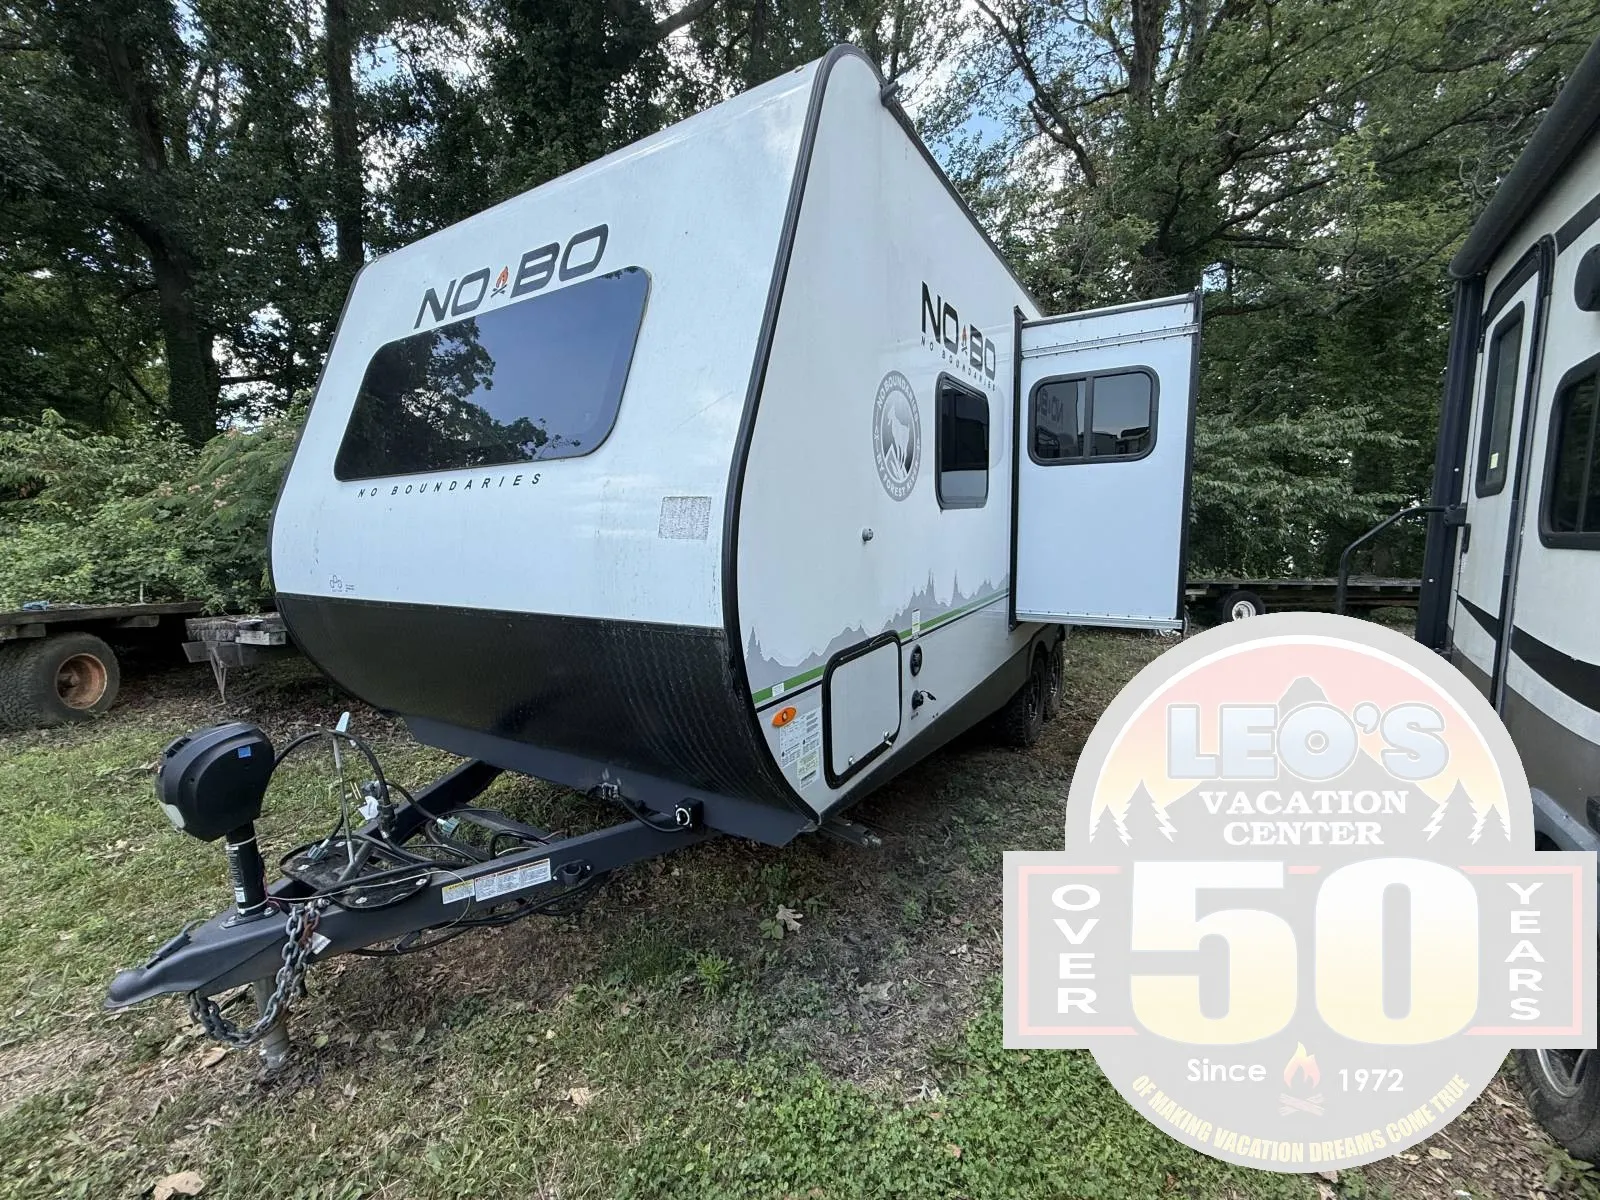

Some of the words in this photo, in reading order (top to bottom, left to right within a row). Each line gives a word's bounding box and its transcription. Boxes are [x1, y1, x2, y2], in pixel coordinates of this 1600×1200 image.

[414, 267, 491, 329] NO
[510, 223, 609, 299] BO
[921, 280, 959, 355] NO
[969, 324, 996, 382] BO
[921, 336, 934, 351] NO
[942, 350, 995, 392] BOUNDARIES
[884, 375, 918, 422] BOUNDARIES
[357, 486, 379, 499] NO
[390, 473, 542, 496] BOUNDARIES
